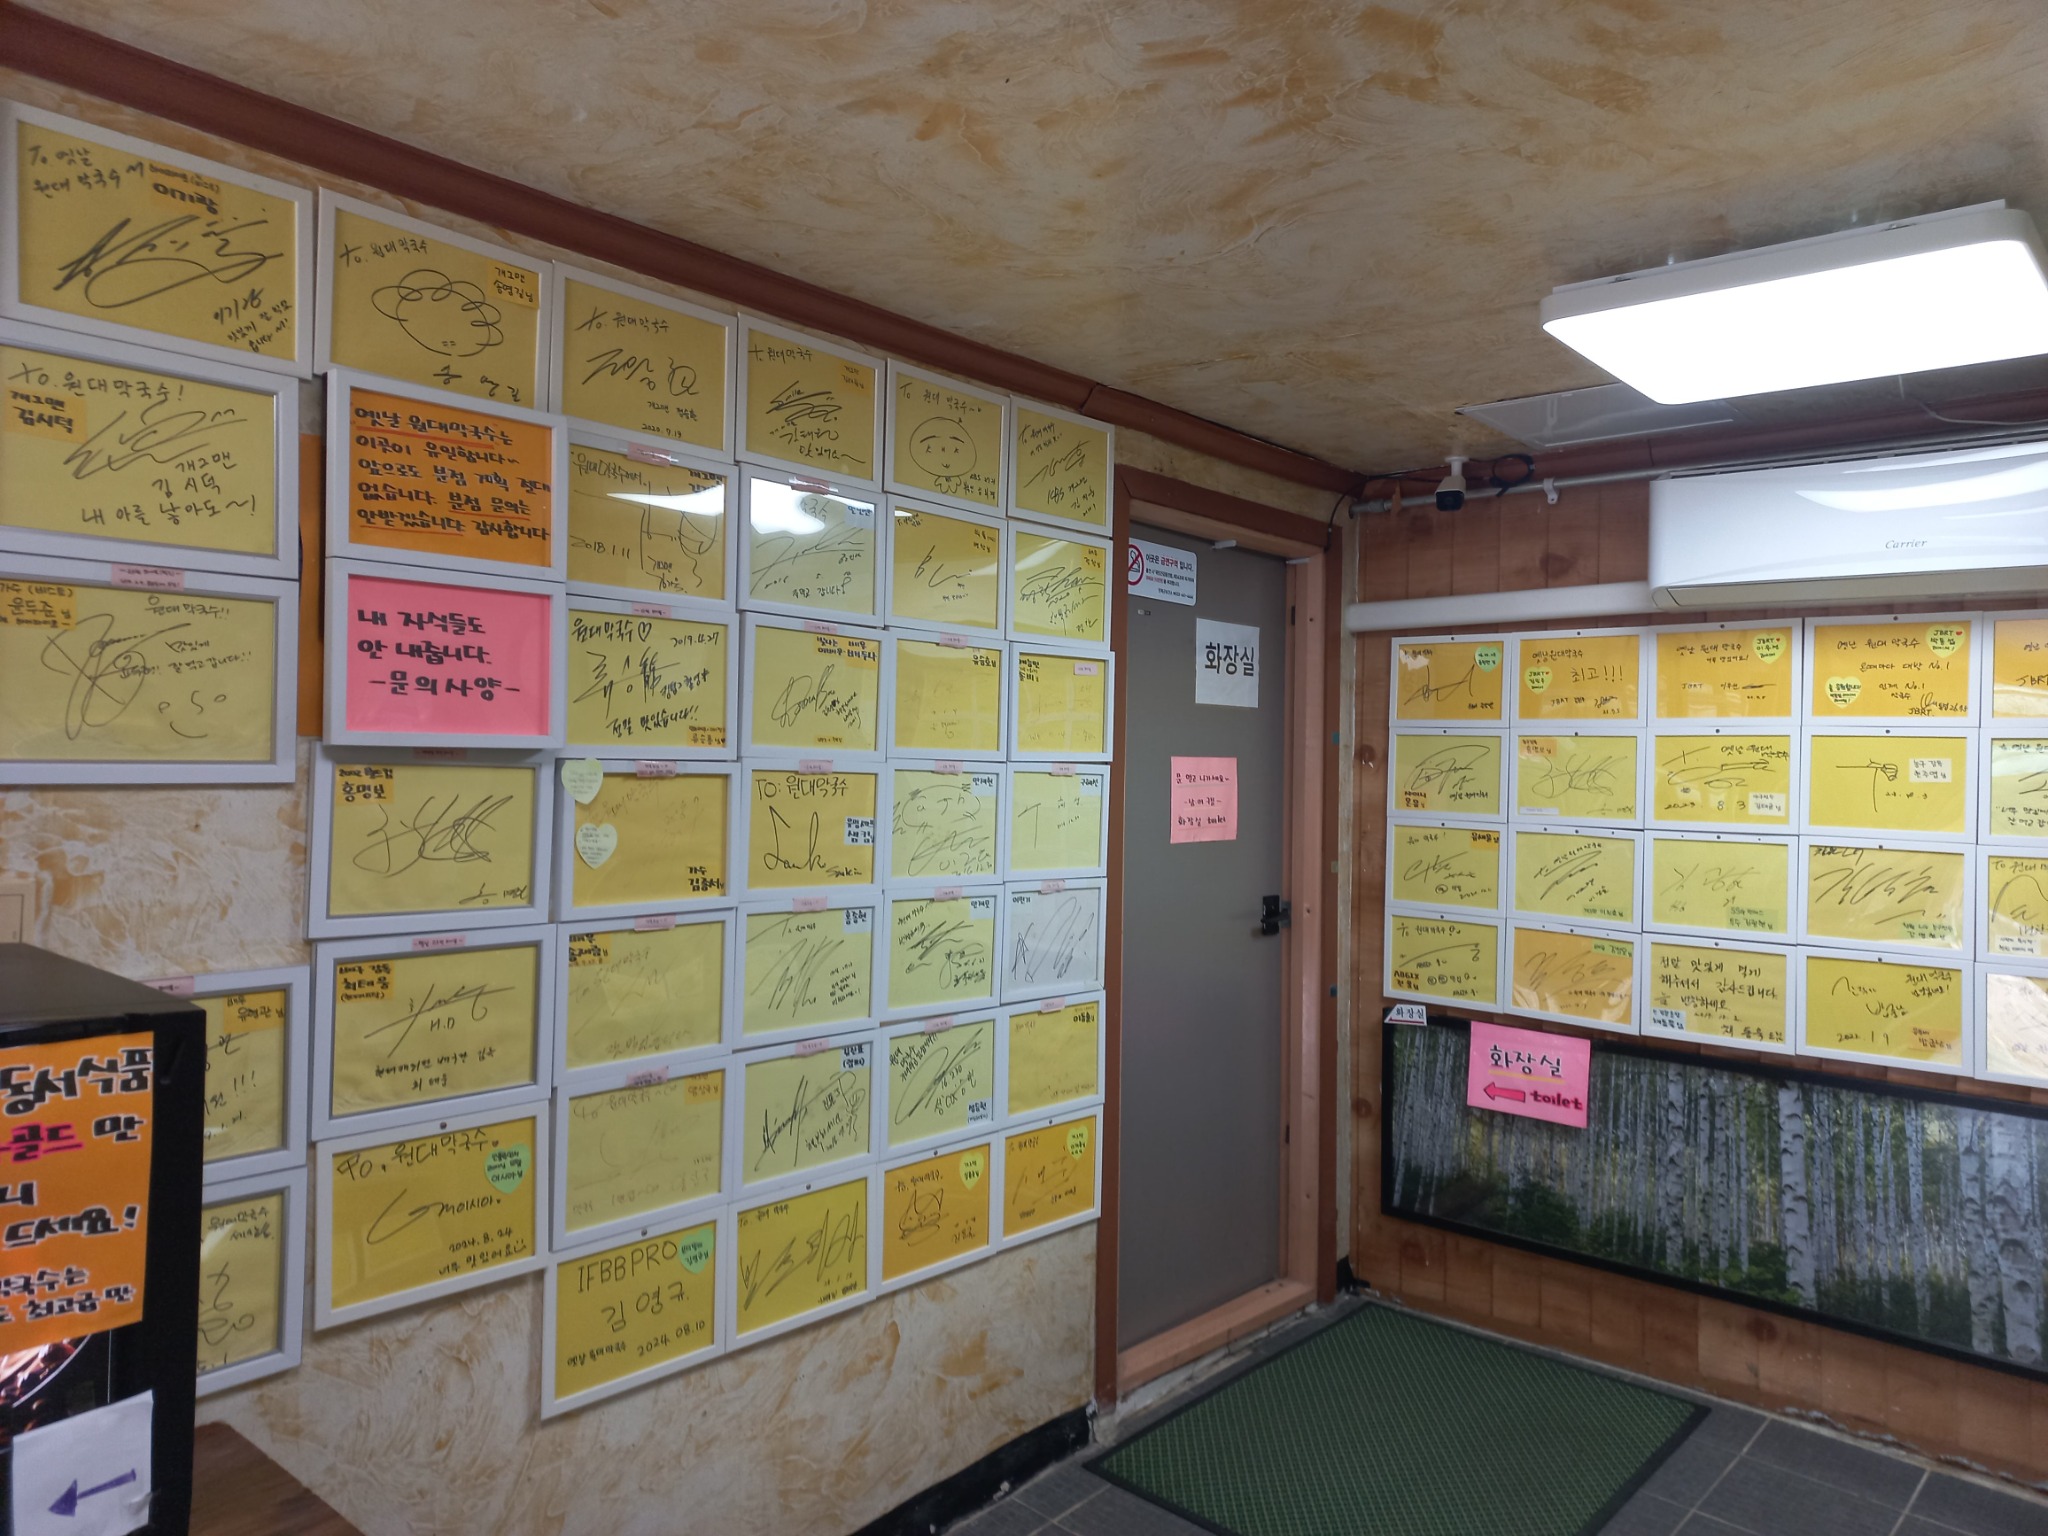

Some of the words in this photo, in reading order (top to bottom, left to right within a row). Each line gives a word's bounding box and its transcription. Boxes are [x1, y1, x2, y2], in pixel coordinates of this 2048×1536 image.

[354, 406, 402, 428] 옛날
[408, 415, 514, 447] 원대막국수는
[175, 451, 239, 474] 개그맨
[358, 459, 423, 478] 앞으로도
[433, 465, 468, 487] 분점
[448, 491, 482, 511] 분점
[491, 495, 532, 515] 문의는
[473, 519, 551, 542] 감사합니다
[1884, 538, 1928, 550] Carrier
[357, 608, 388, 627] 내
[397, 611, 487, 636] 자식들도
[357, 639, 389, 660] 안
[1204, 640, 1256, 678] 화장실
[1395, 1007, 1425, 1021] 화장실
[1489, 1043, 1563, 1079] 화장실
[1529, 1088, 1584, 1112] toilet
[93, 1115, 145, 1144] 만
